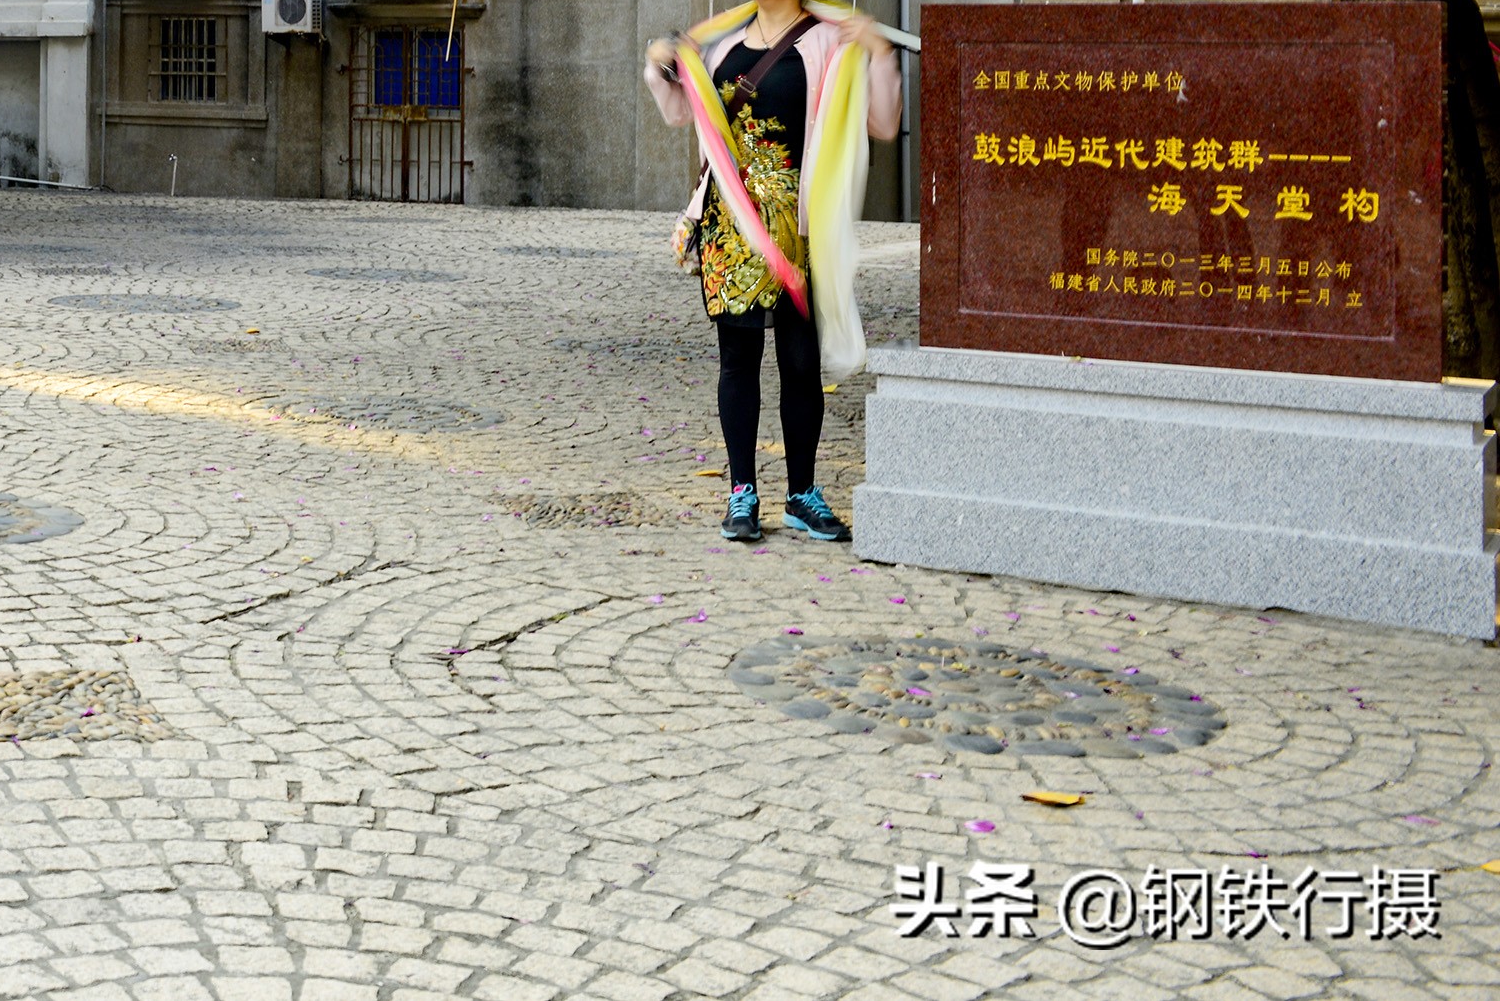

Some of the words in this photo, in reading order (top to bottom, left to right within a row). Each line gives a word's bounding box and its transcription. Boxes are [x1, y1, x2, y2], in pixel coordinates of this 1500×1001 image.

[972, 69, 1185, 93] 全国重点文物保护单位
